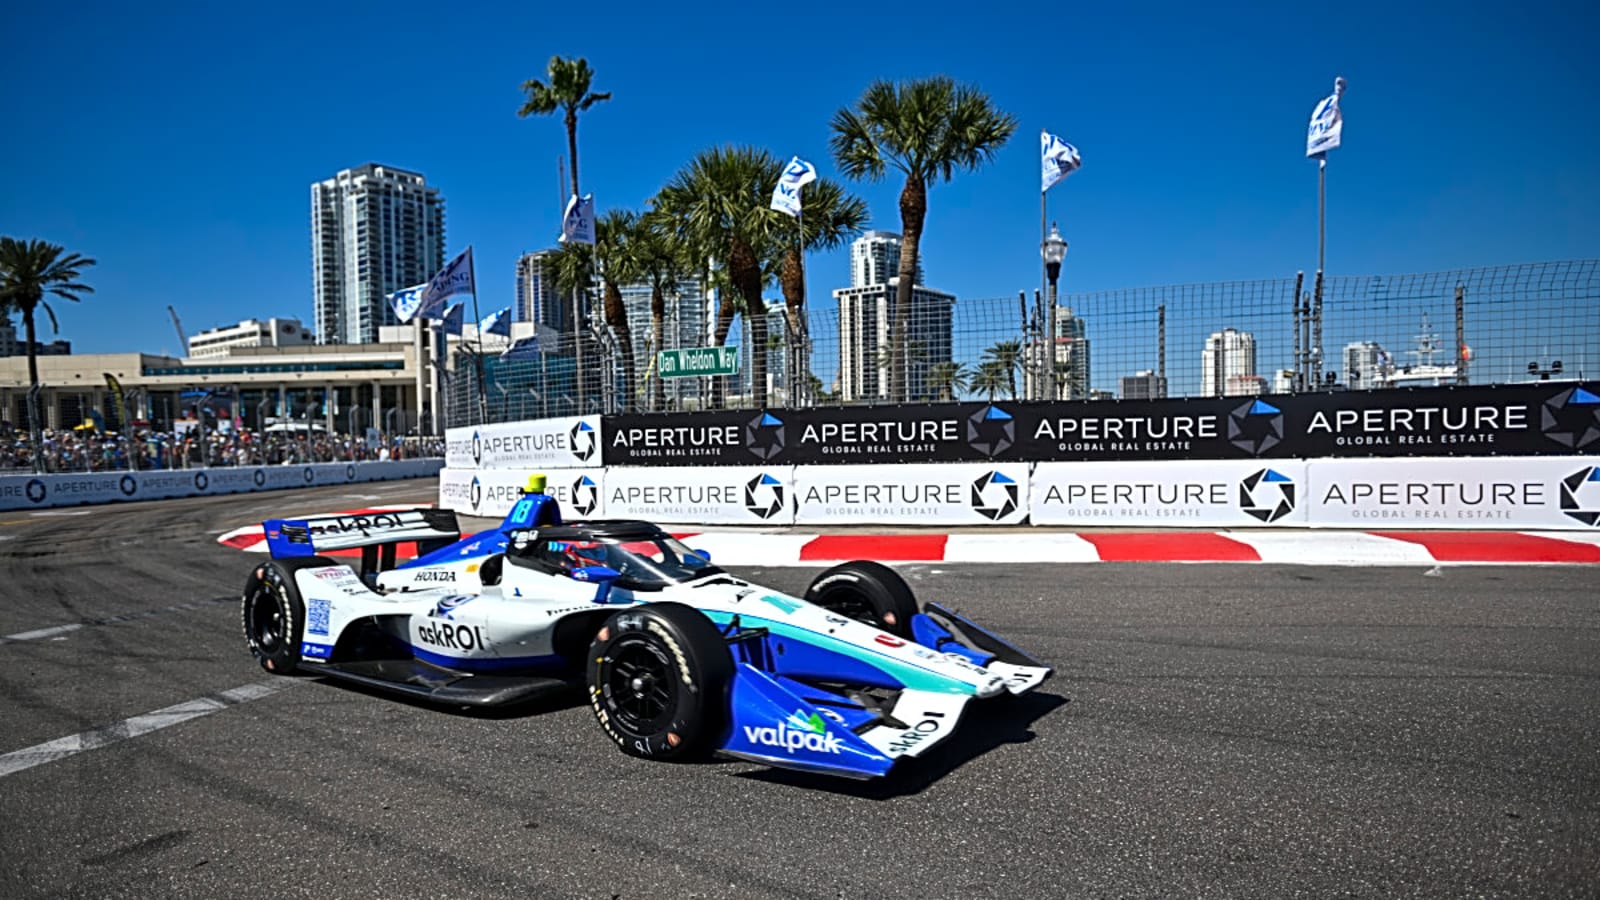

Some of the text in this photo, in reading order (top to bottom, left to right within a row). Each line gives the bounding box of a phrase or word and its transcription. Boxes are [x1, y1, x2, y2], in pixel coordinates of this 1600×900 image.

[660, 347, 737, 374] Dan Wheldon Way
[1034, 416, 1218, 440] APERTURE
[1306, 406, 1528, 434] APERTURE
[612, 426, 740, 447] APERTURE
[800, 420, 959, 444] APERTURE
[1336, 433, 1494, 446] GLOBAL REAL ESTATE
[483, 432, 567, 454] APERTURE
[630, 447, 721, 457] GLOBAL REAL ESTATE
[822, 443, 935, 454] GLOBAL REAL ESTATE
[1059, 441, 1190, 451] GLOBAL REAL ESTATE
[54, 479, 118, 494] APERTURE
[486, 485, 567, 502] APERE
[611, 485, 738, 504] APERTURE
[804, 484, 962, 504] APERTURE
[1043, 483, 1229, 505] APERTURE
[1322, 483, 1546, 506] APERTURE
[511, 500, 533, 523] 18
[687, 506, 719, 514] ESTATE
[825, 507, 938, 515] GLOBAL REAL ESTATE
[1067, 508, 1201, 517] GLOBAL REAL ESTATE
[1352, 509, 1512, 520] GLOBAL REAL ESTATE
[414, 571, 456, 582] HONDA
[419, 621, 485, 650] askROI
[743, 719, 842, 755] valpak
